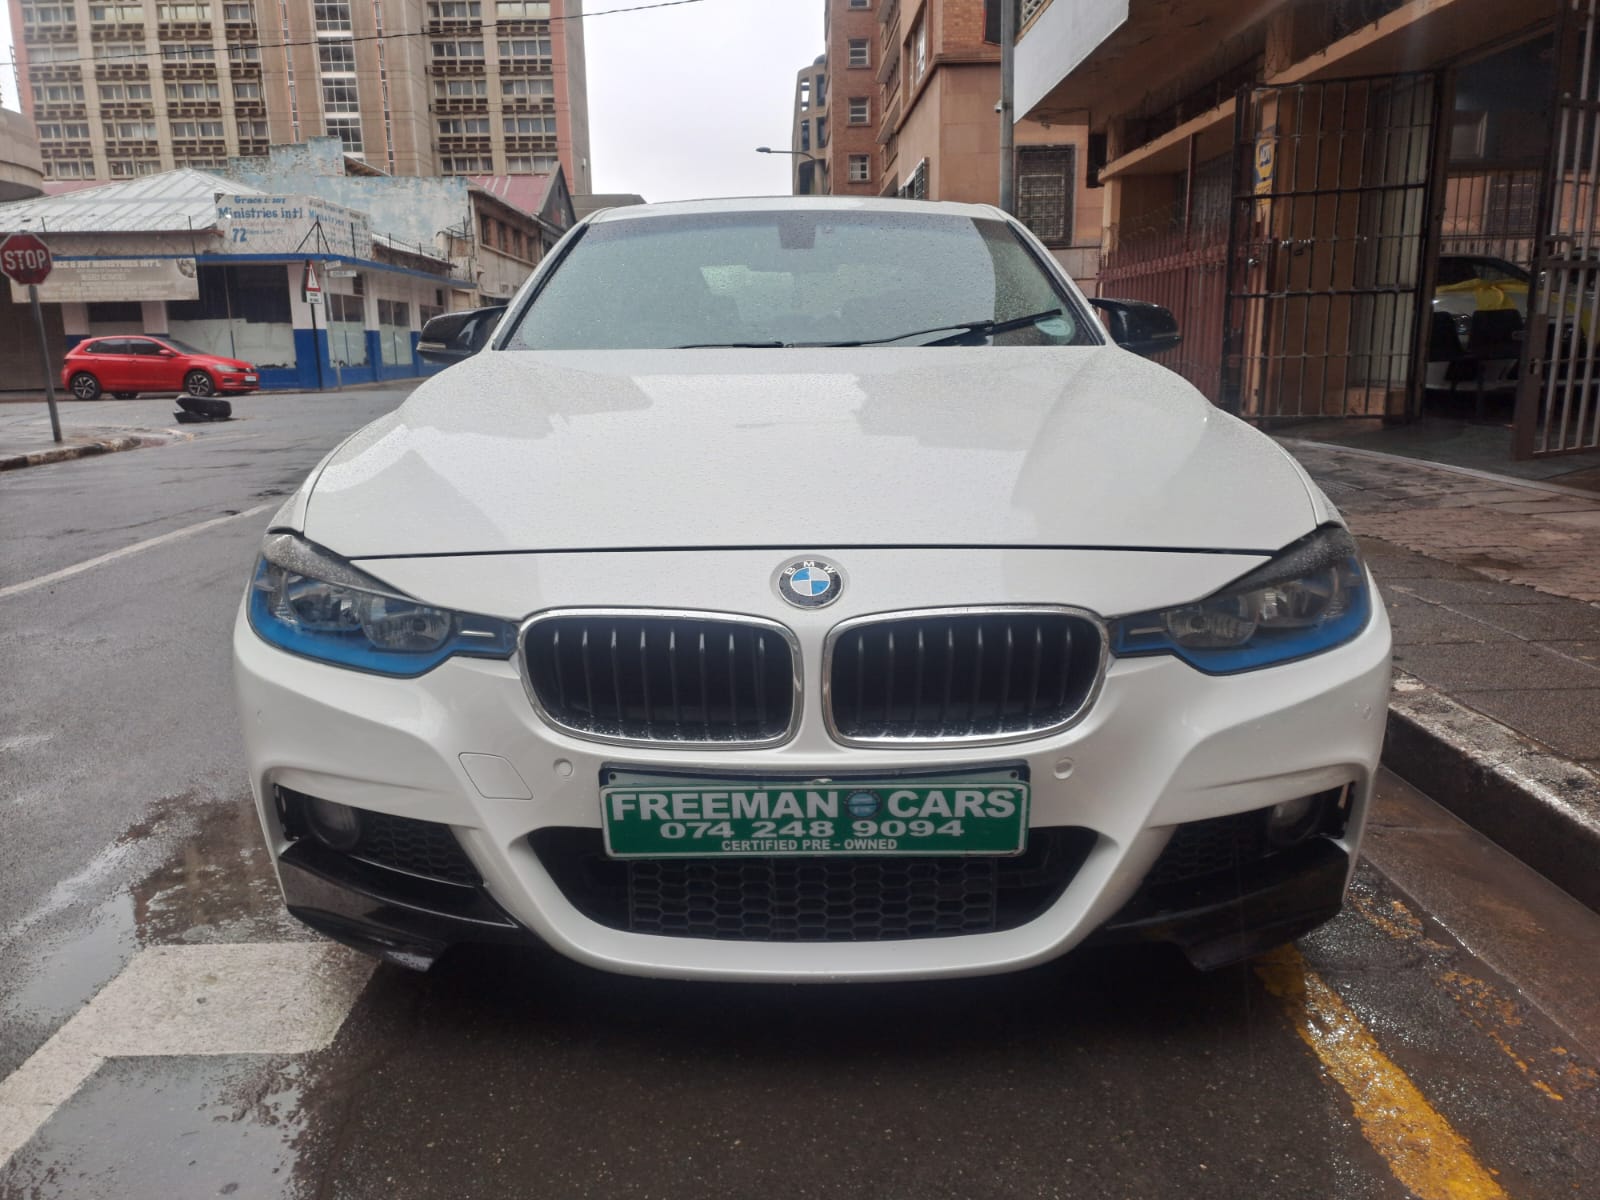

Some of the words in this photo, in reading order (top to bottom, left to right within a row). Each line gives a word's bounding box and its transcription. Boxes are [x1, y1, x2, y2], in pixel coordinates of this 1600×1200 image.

[217, 207, 278, 219] Ministries
[232, 227, 248, 243] 72
[4, 250, 46, 270] STOP
[784, 560, 837, 575] BMW
[611, 791, 839, 821] FREEMAN
[887, 790, 1016, 818] CARS
[659, 821, 735, 839] 074
[751, 820, 835, 839] 248
[851, 819, 965, 838] 9094
[721, 839, 798, 851] CERTIFIED
[802, 839, 831, 850] PRE
[844, 838, 898, 850] OWNED
